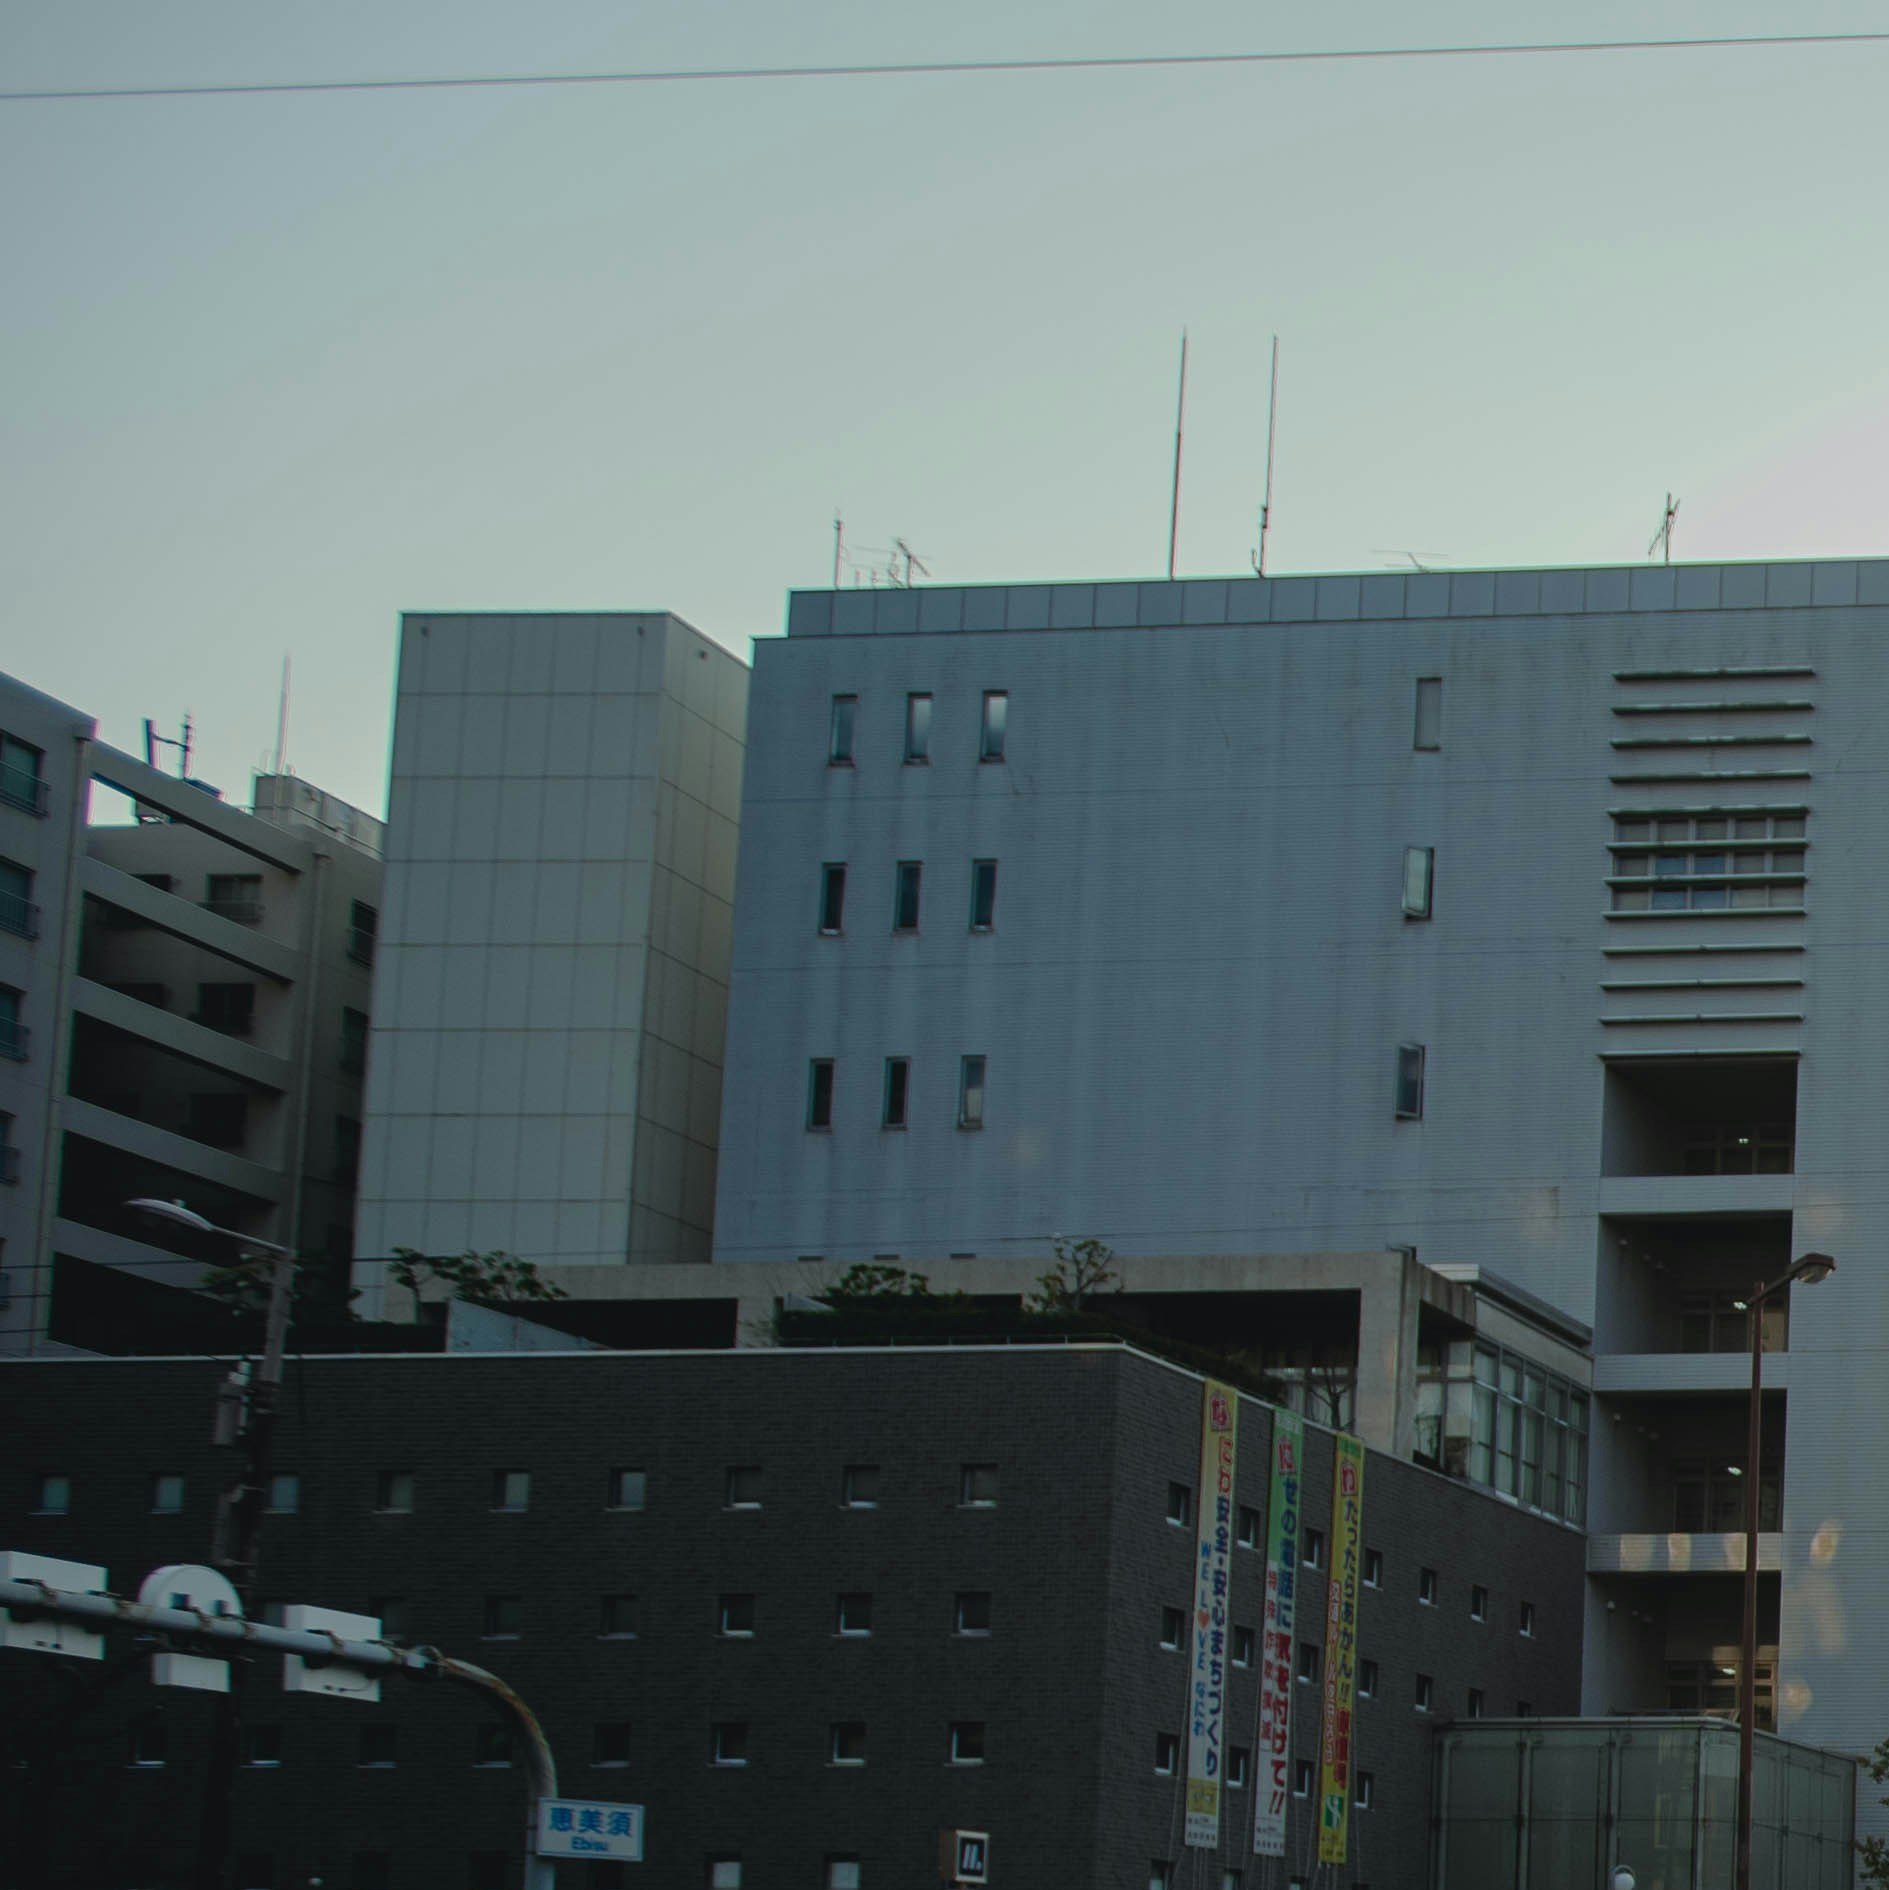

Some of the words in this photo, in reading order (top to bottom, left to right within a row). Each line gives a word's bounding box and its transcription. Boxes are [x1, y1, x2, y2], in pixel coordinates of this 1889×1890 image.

[550, 1807, 632, 1836] 恵美須
[571, 1836, 607, 1850] Ebisu
